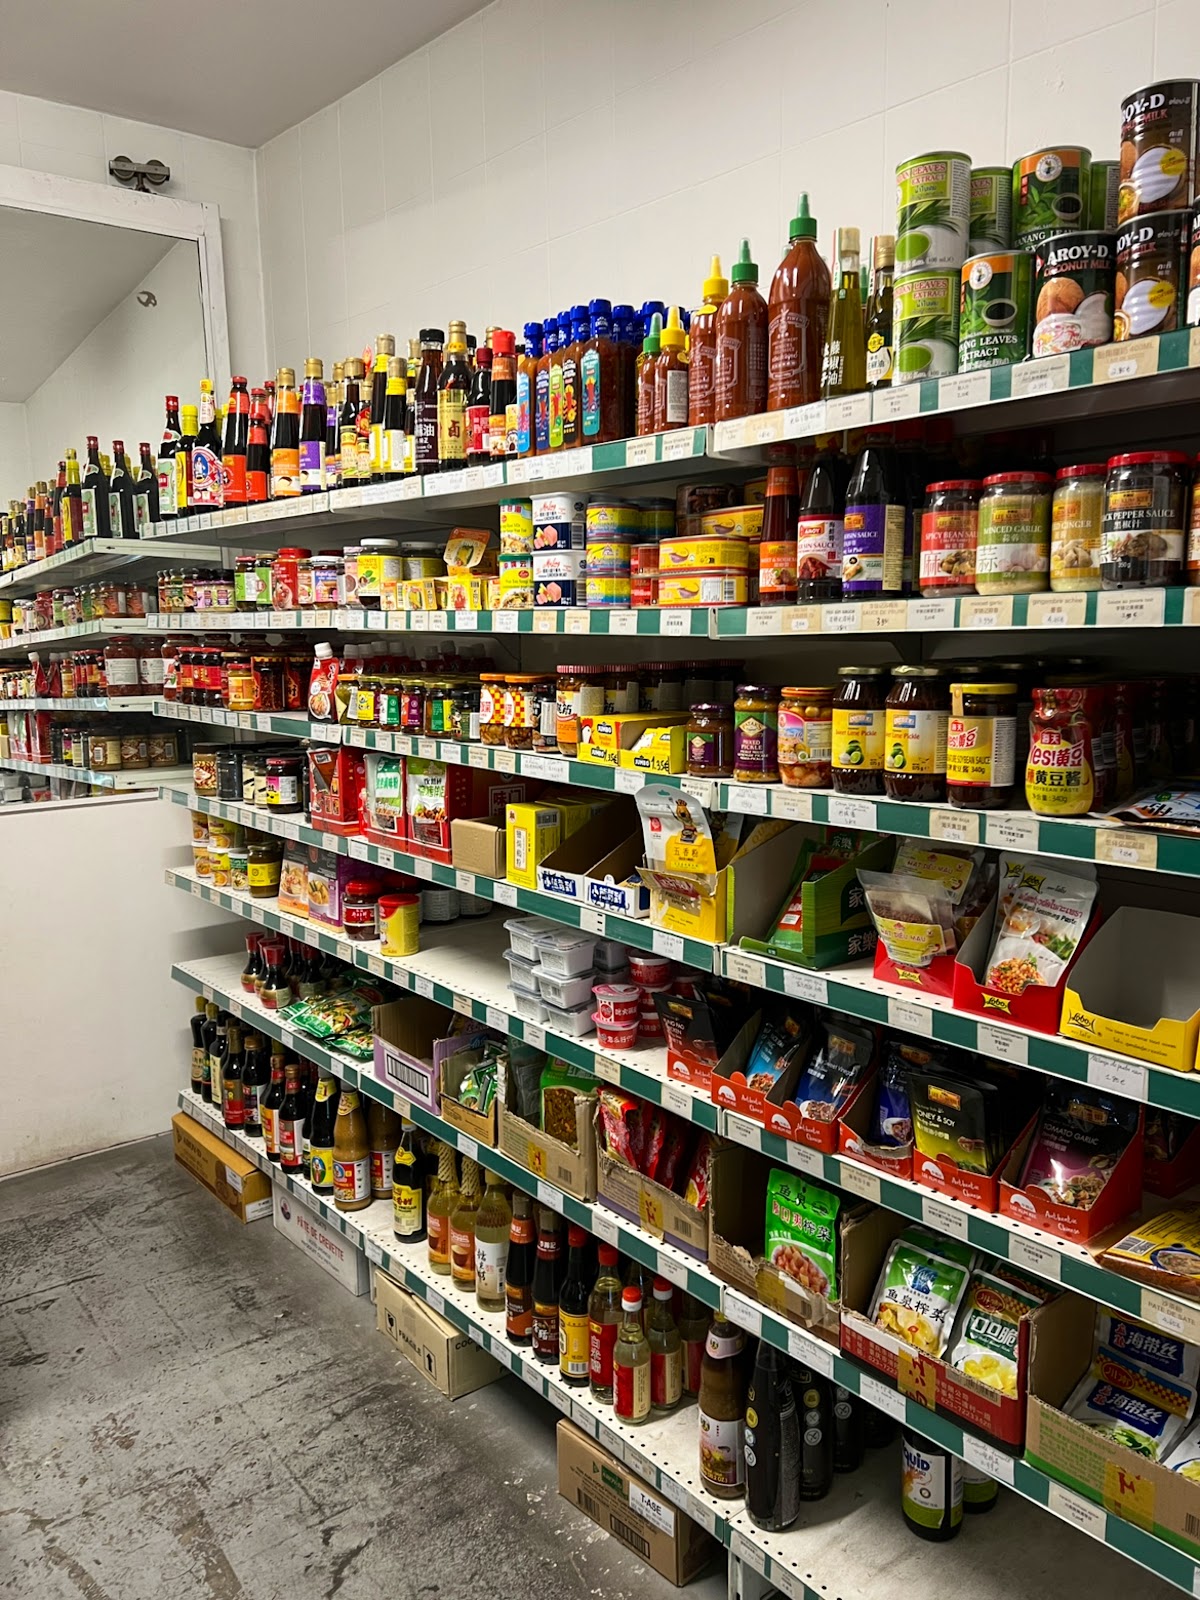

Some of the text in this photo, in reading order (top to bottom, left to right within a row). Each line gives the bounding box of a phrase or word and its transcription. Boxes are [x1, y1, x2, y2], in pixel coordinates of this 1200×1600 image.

[911, 163, 947, 180] LEAVES
[1046, 245, 1109, 266] AROY-D
[913, 280, 947, 292] LEAVES
[979, 334, 1018, 346] LEAVES
[961, 347, 1000, 363] EXTRACT
[1113, 511, 1145, 521] PEPPER
[1145, 510, 1175, 519] SAUCE
[983, 525, 1044, 535] MINCED GARLIC
[942, 1116, 956, 1128] SOY
[1043, 1123, 1073, 1139] TOMATO
[640, 1492, 662, 1516] T-ASE
